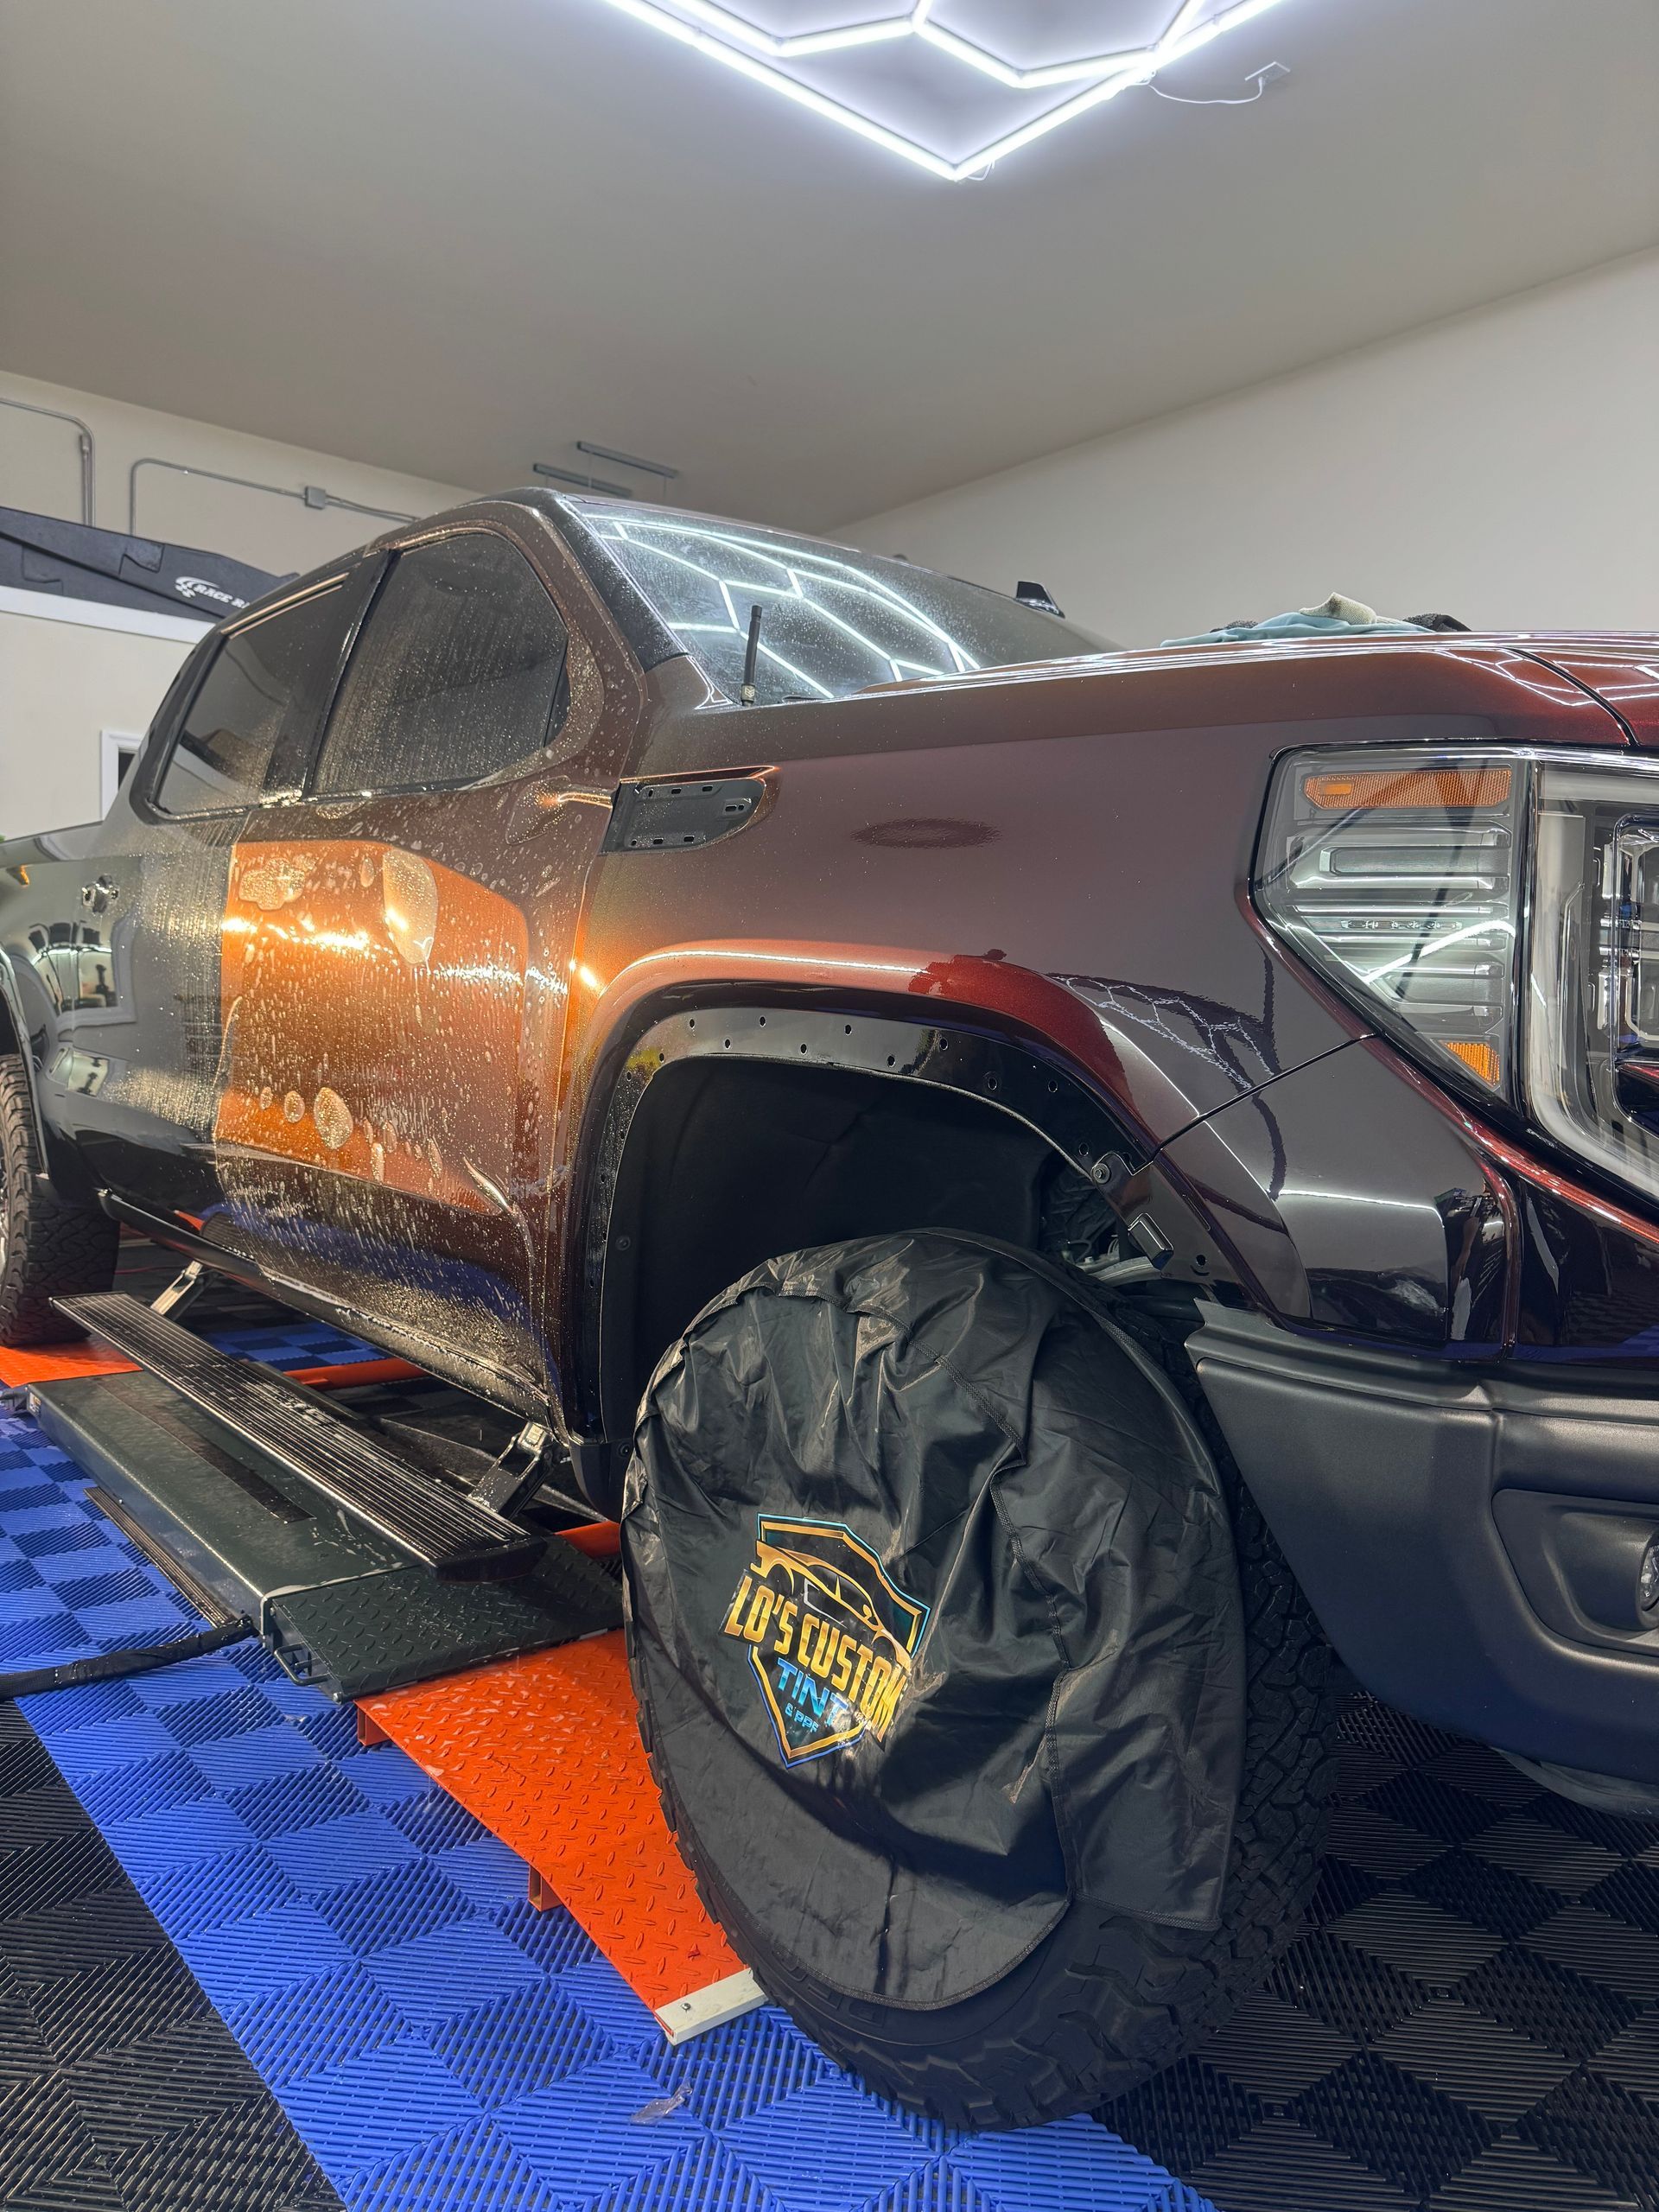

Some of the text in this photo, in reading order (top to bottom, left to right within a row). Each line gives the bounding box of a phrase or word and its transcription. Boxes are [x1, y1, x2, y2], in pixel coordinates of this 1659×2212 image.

[193, 584, 232, 603] RACE
[725, 1575, 906, 1743] LO'S CUSTOM
[777, 1657, 849, 1726] TINT
[785, 1703, 819, 1732] & PPF
